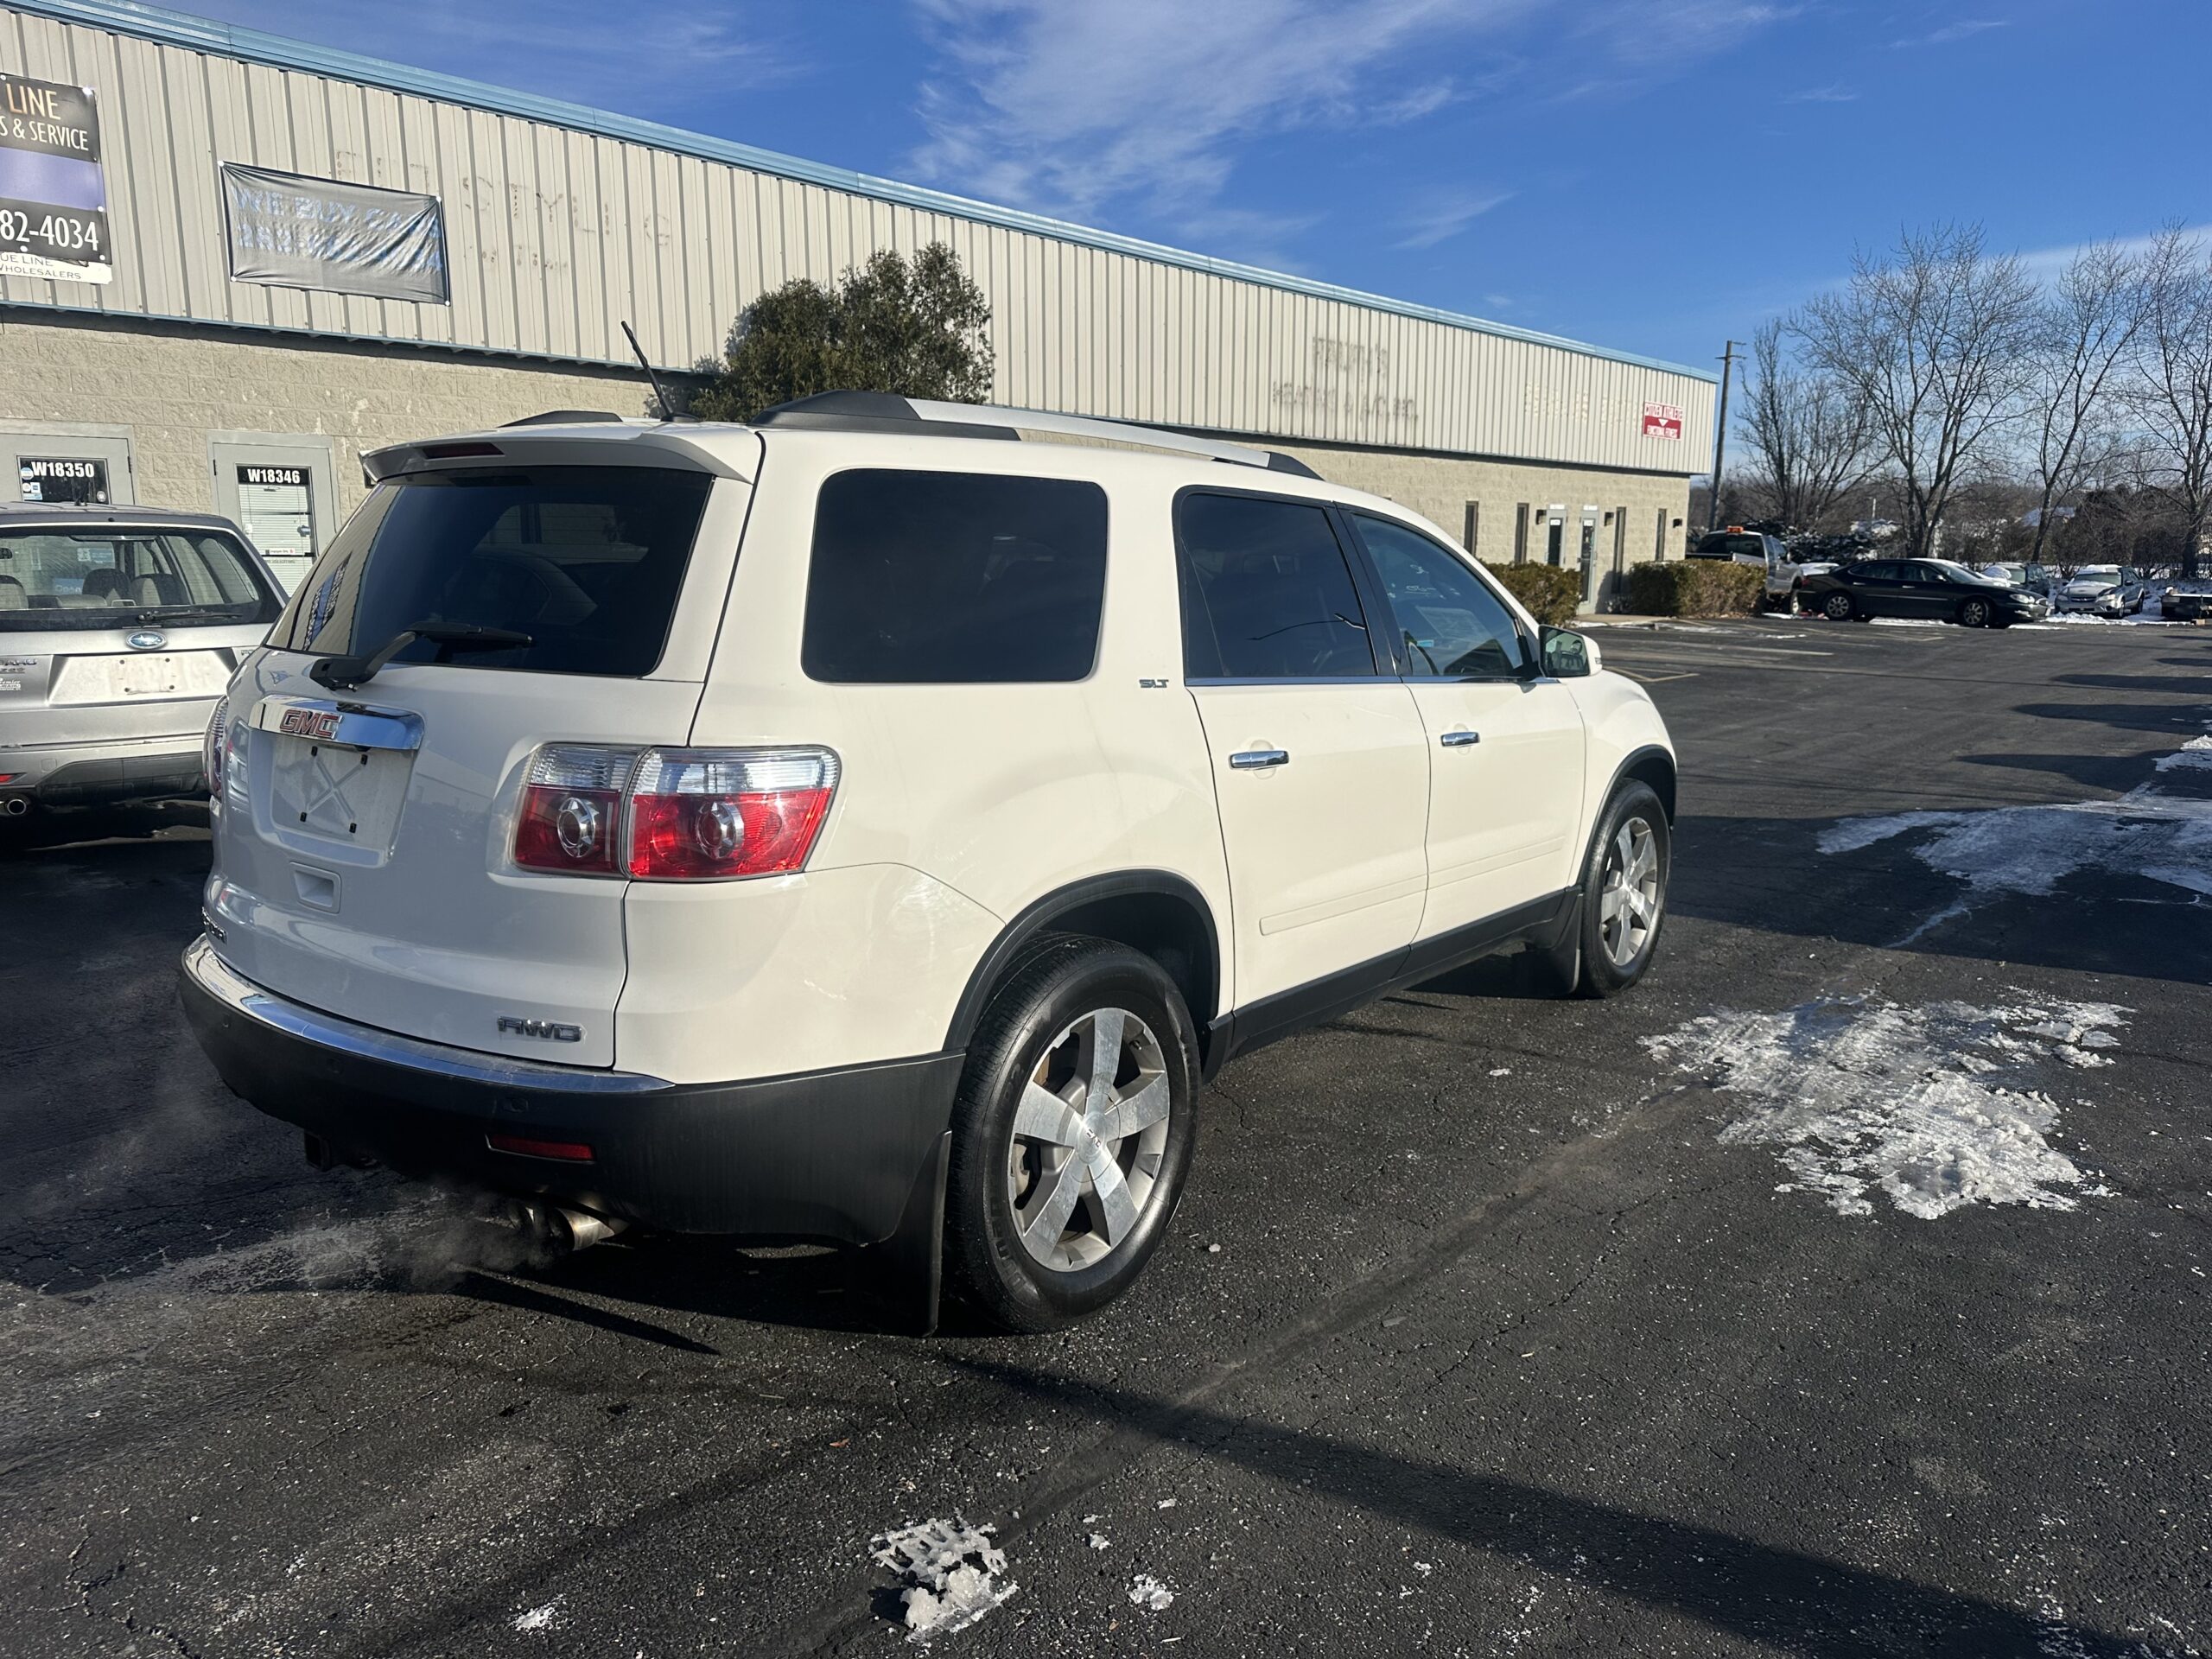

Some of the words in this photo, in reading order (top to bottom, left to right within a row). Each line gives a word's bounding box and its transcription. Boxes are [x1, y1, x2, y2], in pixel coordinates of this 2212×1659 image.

[6, 83, 61, 120] LINE
[13, 118, 25, 140] &
[29, 120, 89, 151] SERVICE
[0, 209, 99, 251] 82-4034
[22, 255, 54, 267] LINE
[31, 461, 95, 478] W18350
[247, 468, 301, 484] W18346
[1139, 679, 1169, 688] SLT
[280, 709, 343, 739] GMC
[498, 1016, 582, 1042] AWD
